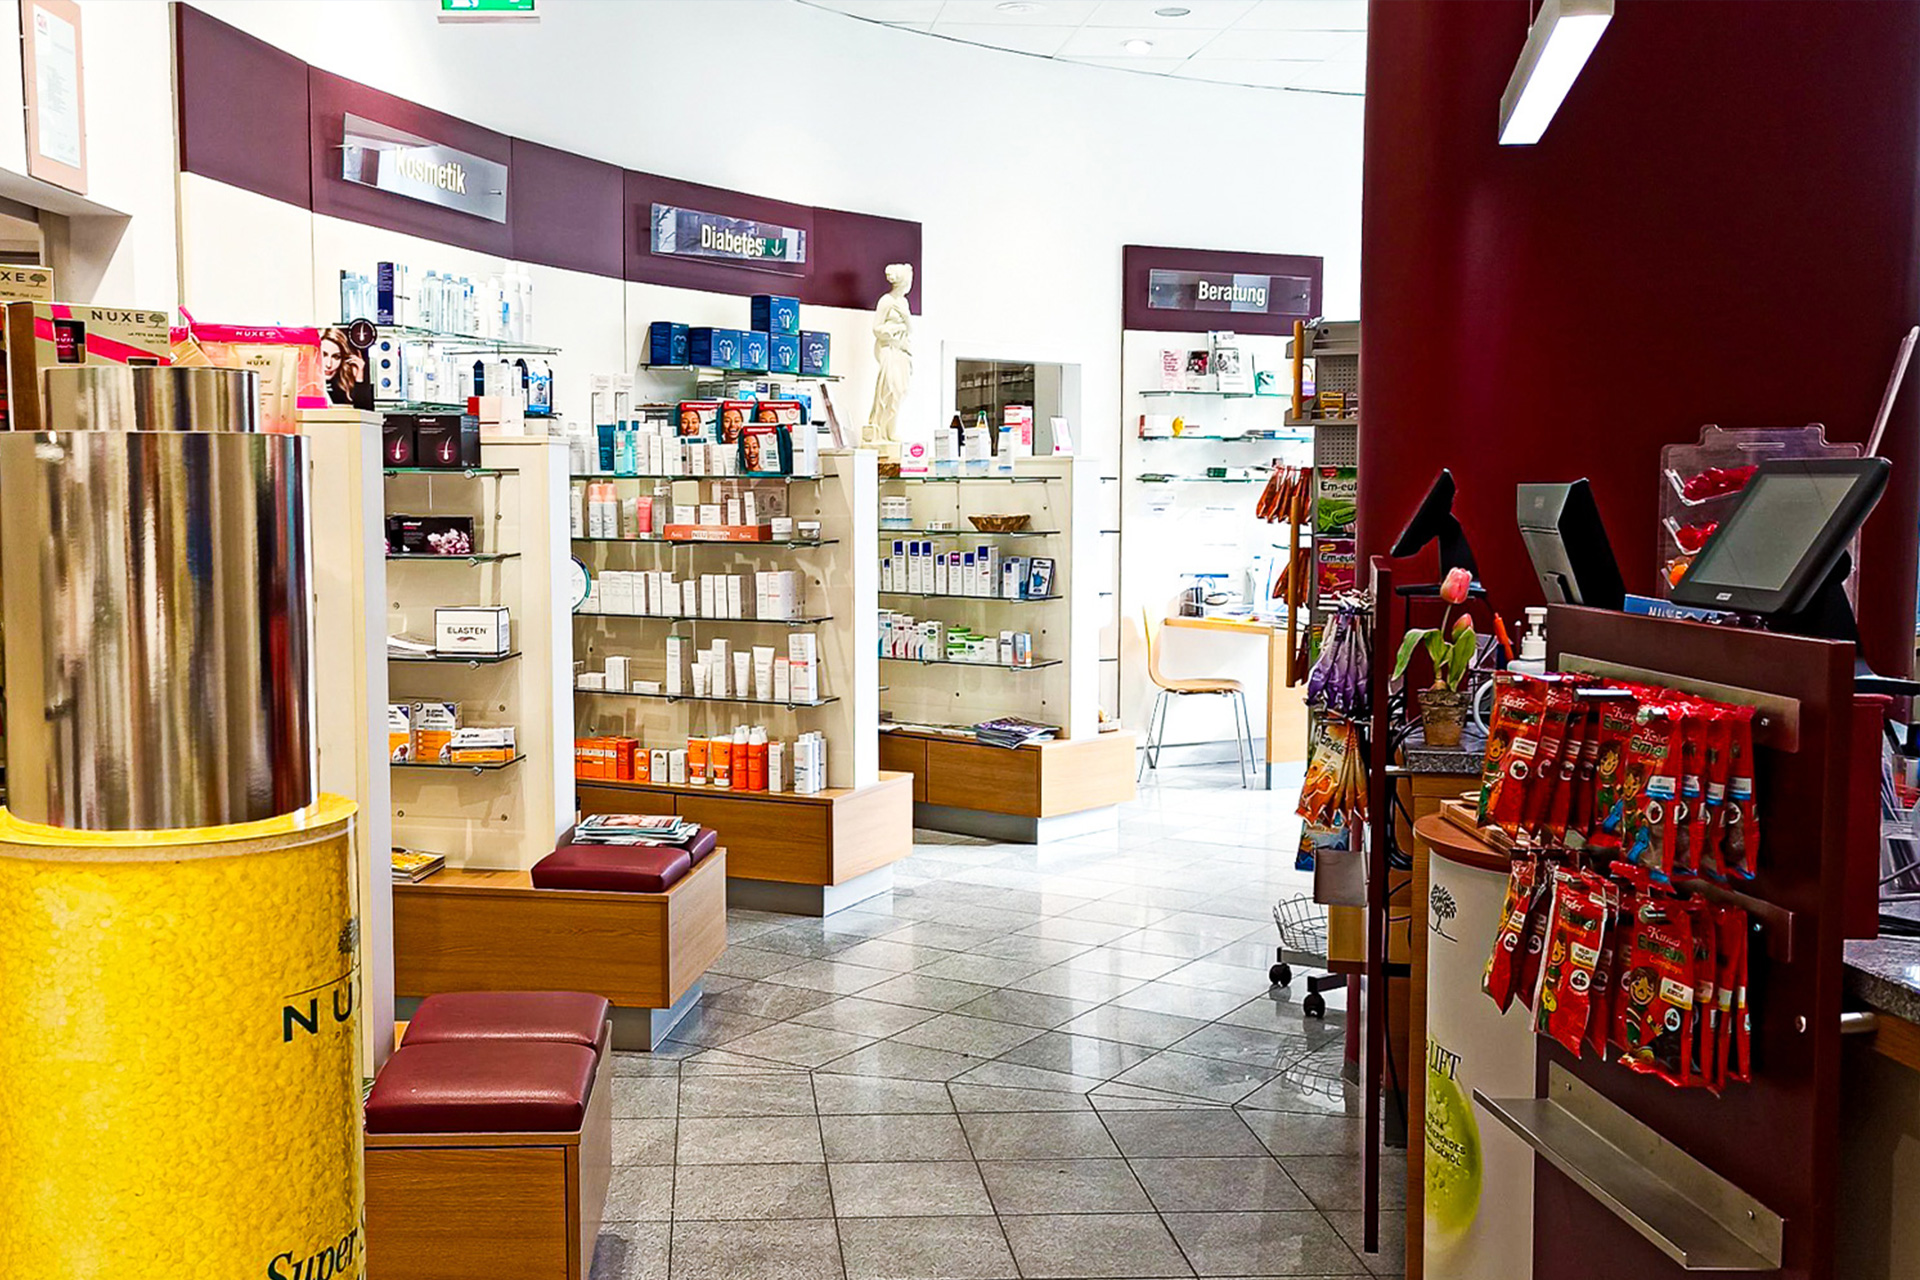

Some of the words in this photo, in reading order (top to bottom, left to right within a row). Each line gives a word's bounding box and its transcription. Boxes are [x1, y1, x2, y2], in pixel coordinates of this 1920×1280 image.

[394, 145, 467, 195] Kosmetik
[701, 224, 763, 257] Diabetes
[1198, 280, 1266, 307] Beratung
[91, 310, 146, 324] NUXE
[446, 626, 488, 636] ELASTEN
[1429, 1040, 1462, 1081] LIFT
